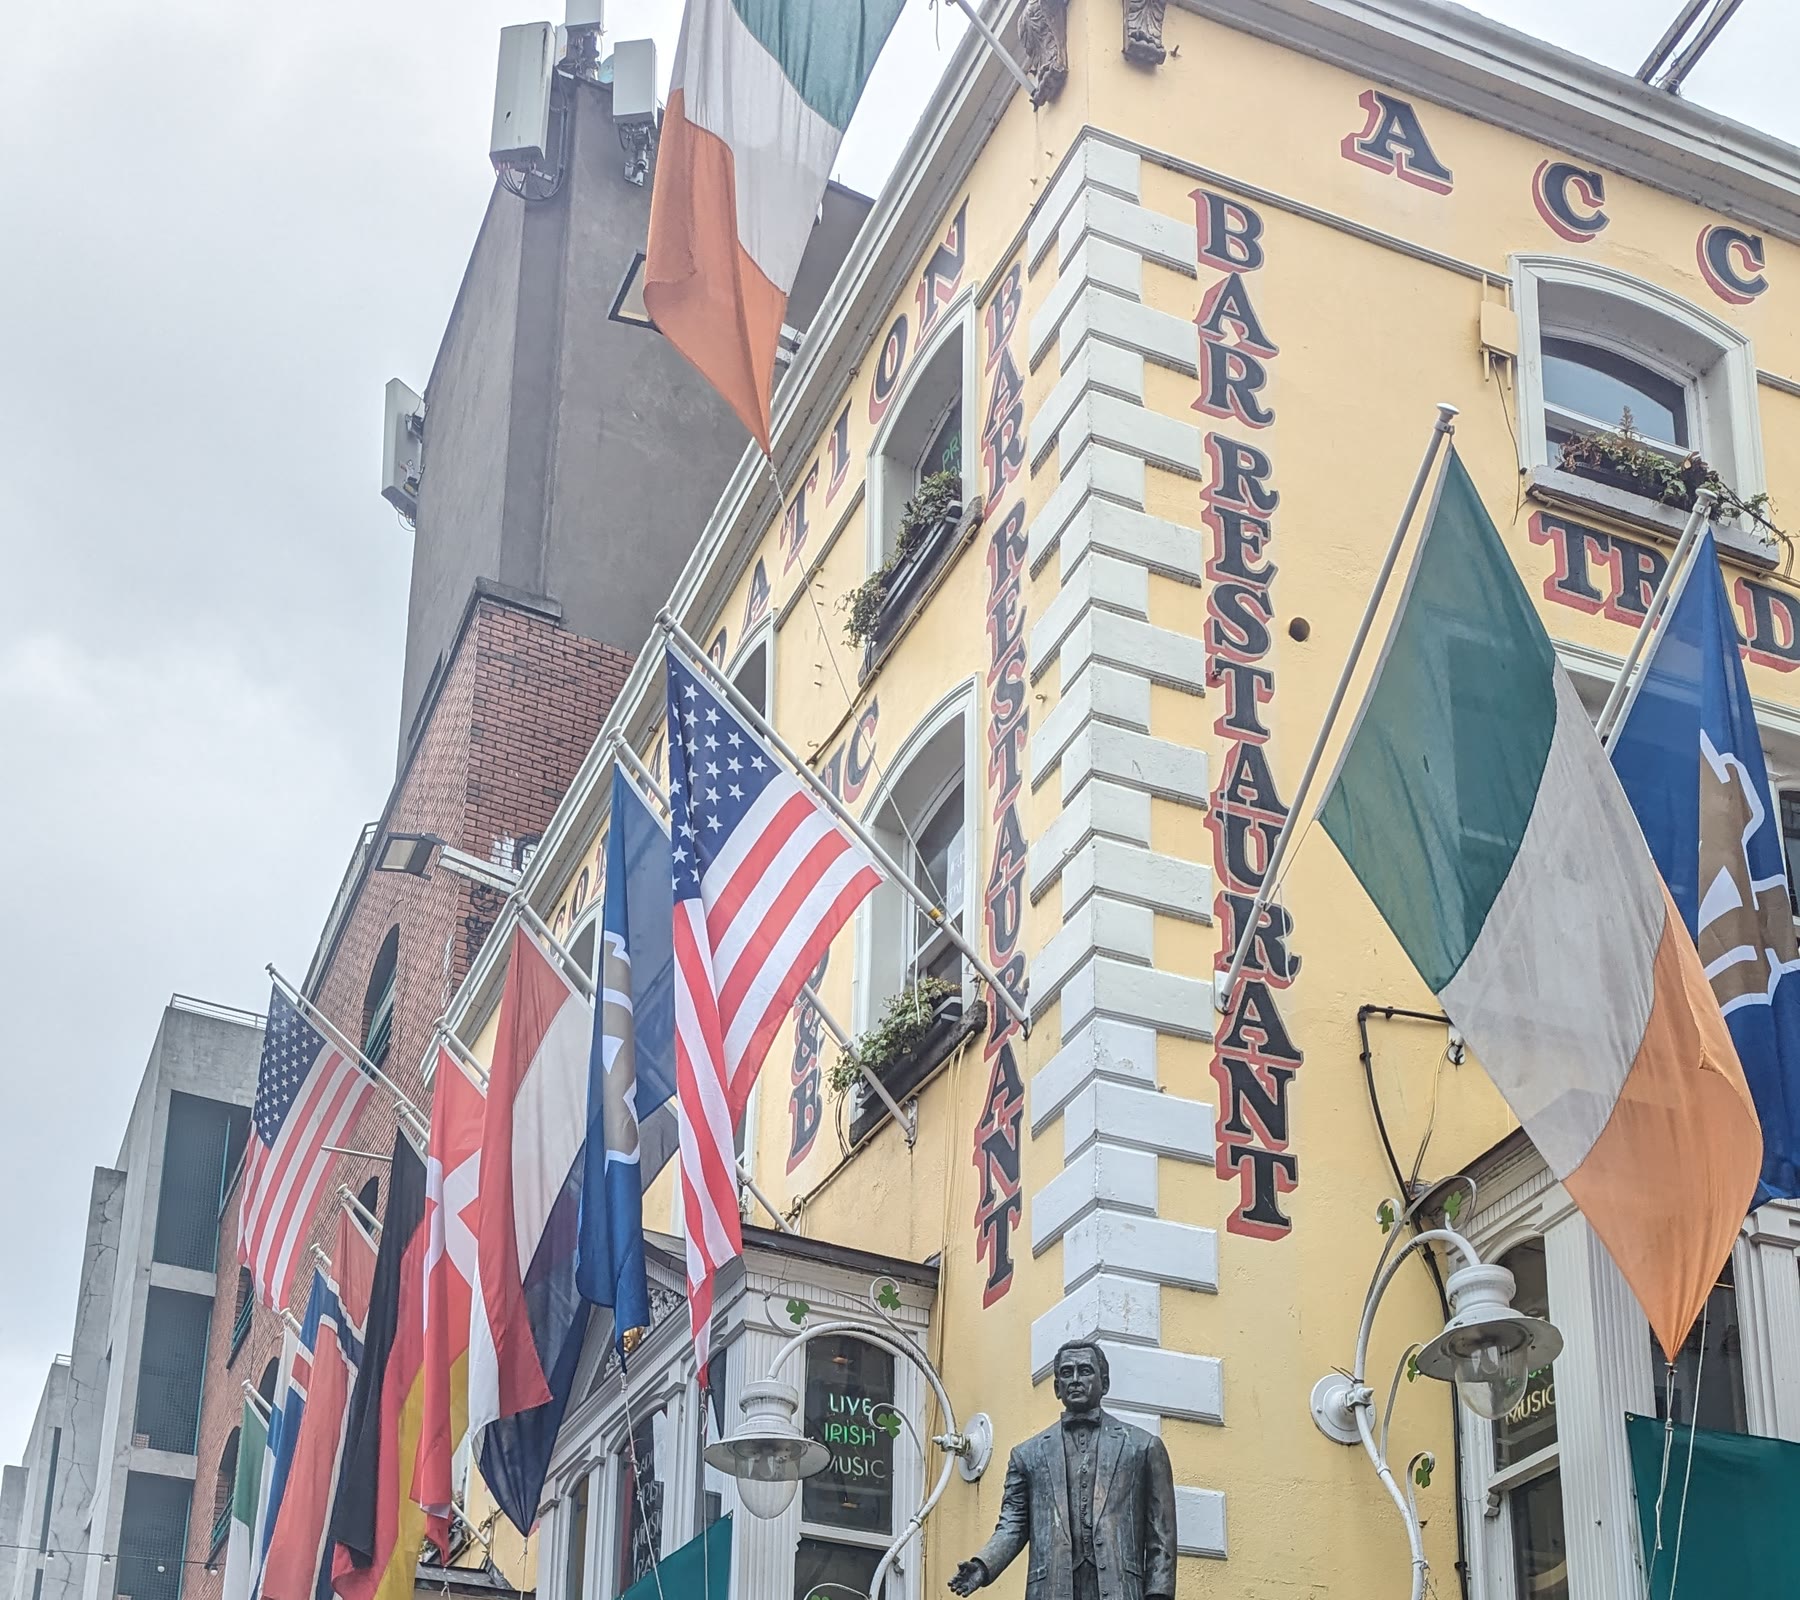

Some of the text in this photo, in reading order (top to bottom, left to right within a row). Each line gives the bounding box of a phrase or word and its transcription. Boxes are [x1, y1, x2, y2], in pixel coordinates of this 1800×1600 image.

[1528, 510, 1800, 673] TRD
[973, 260, 1030, 1309] BAR RESTAURANT
[1189, 189, 1304, 1240] BAR RESTAURANT
[824, 1422, 876, 1447] IRISH
[829, 1393, 872, 1417] LIVE
